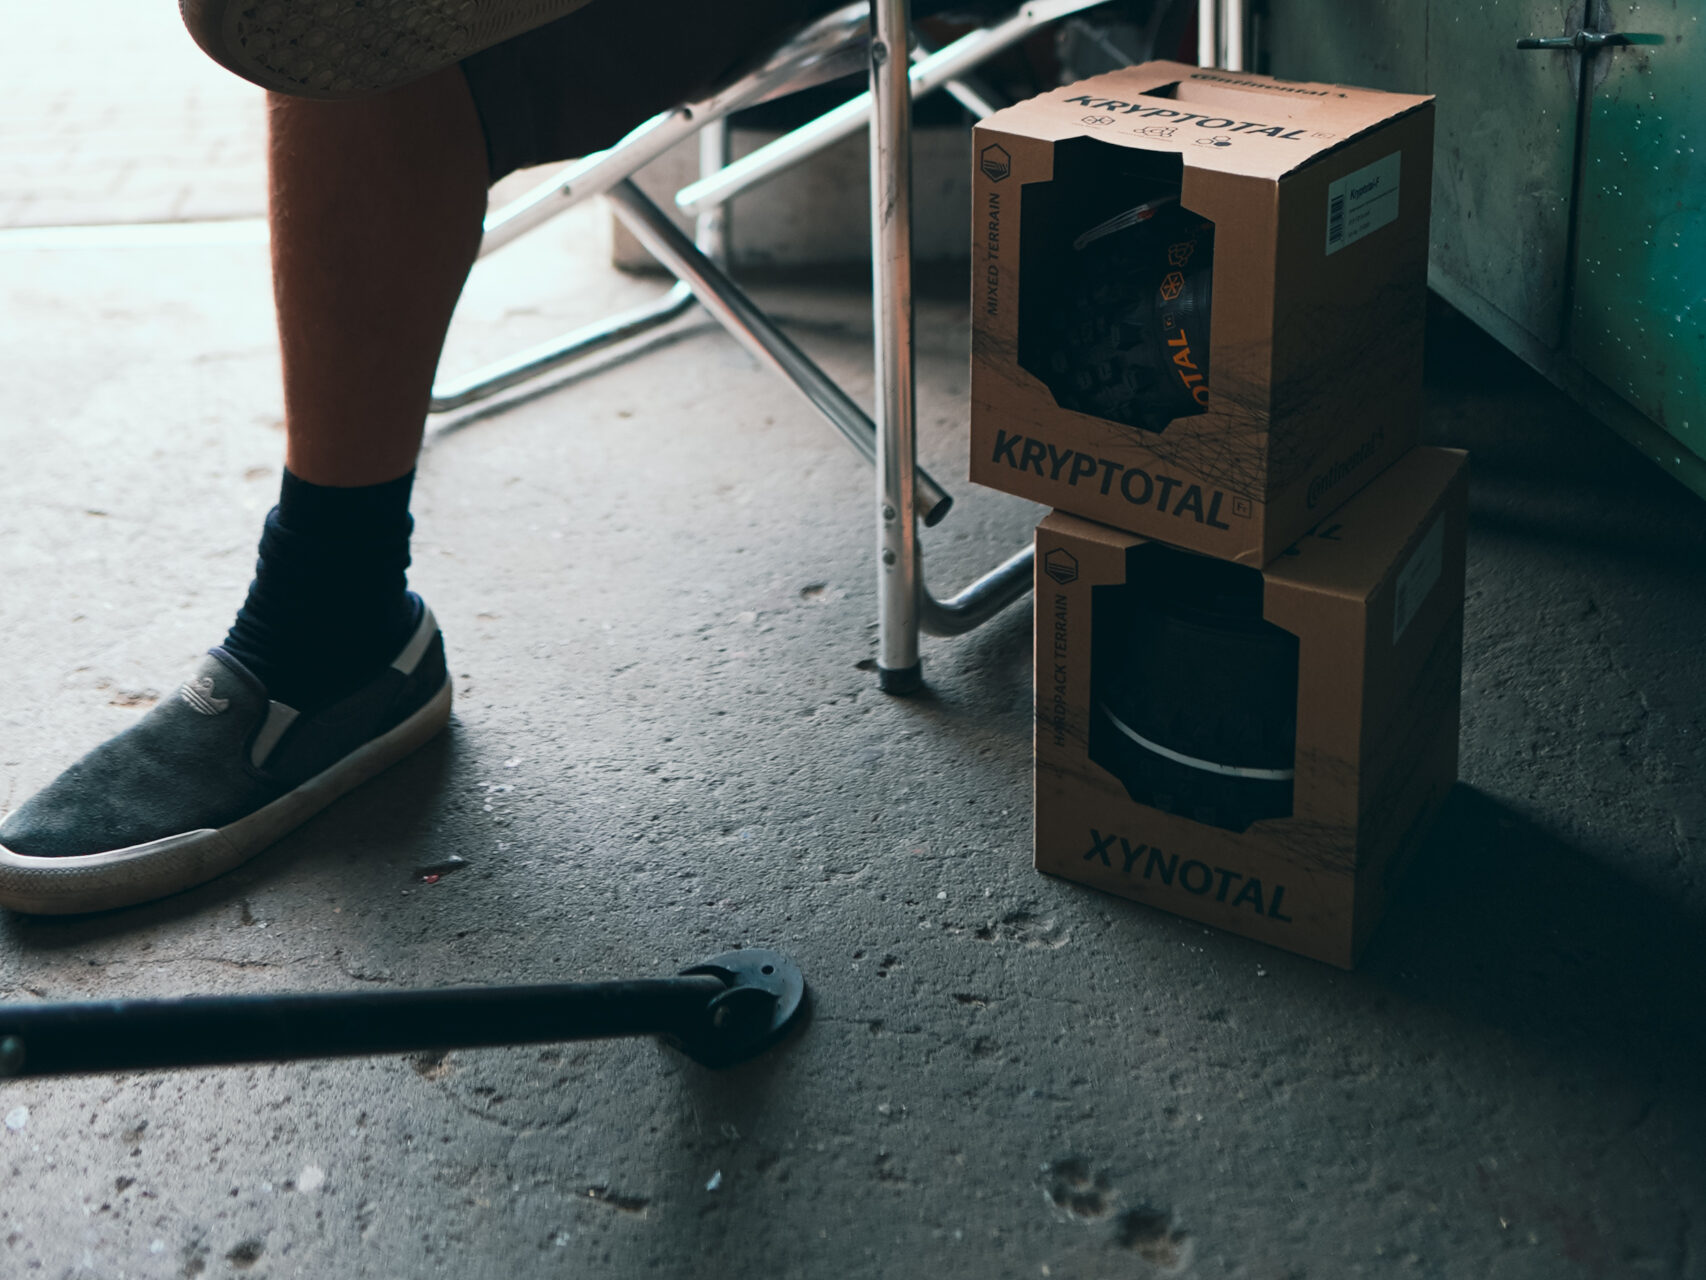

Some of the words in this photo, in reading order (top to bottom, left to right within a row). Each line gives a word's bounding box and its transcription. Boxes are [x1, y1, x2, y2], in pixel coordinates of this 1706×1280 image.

[1064, 94, 1311, 141] KRYPTOTAL
[987, 192, 1001, 261] TERRAIN
[986, 264, 1000, 317] MIXED
[991, 429, 1231, 531] KRYPTOTAL
[1053, 593, 1068, 659] TERRAIN
[1053, 663, 1067, 748] HARDPACK
[1082, 827, 1293, 923] XYNOTAL
